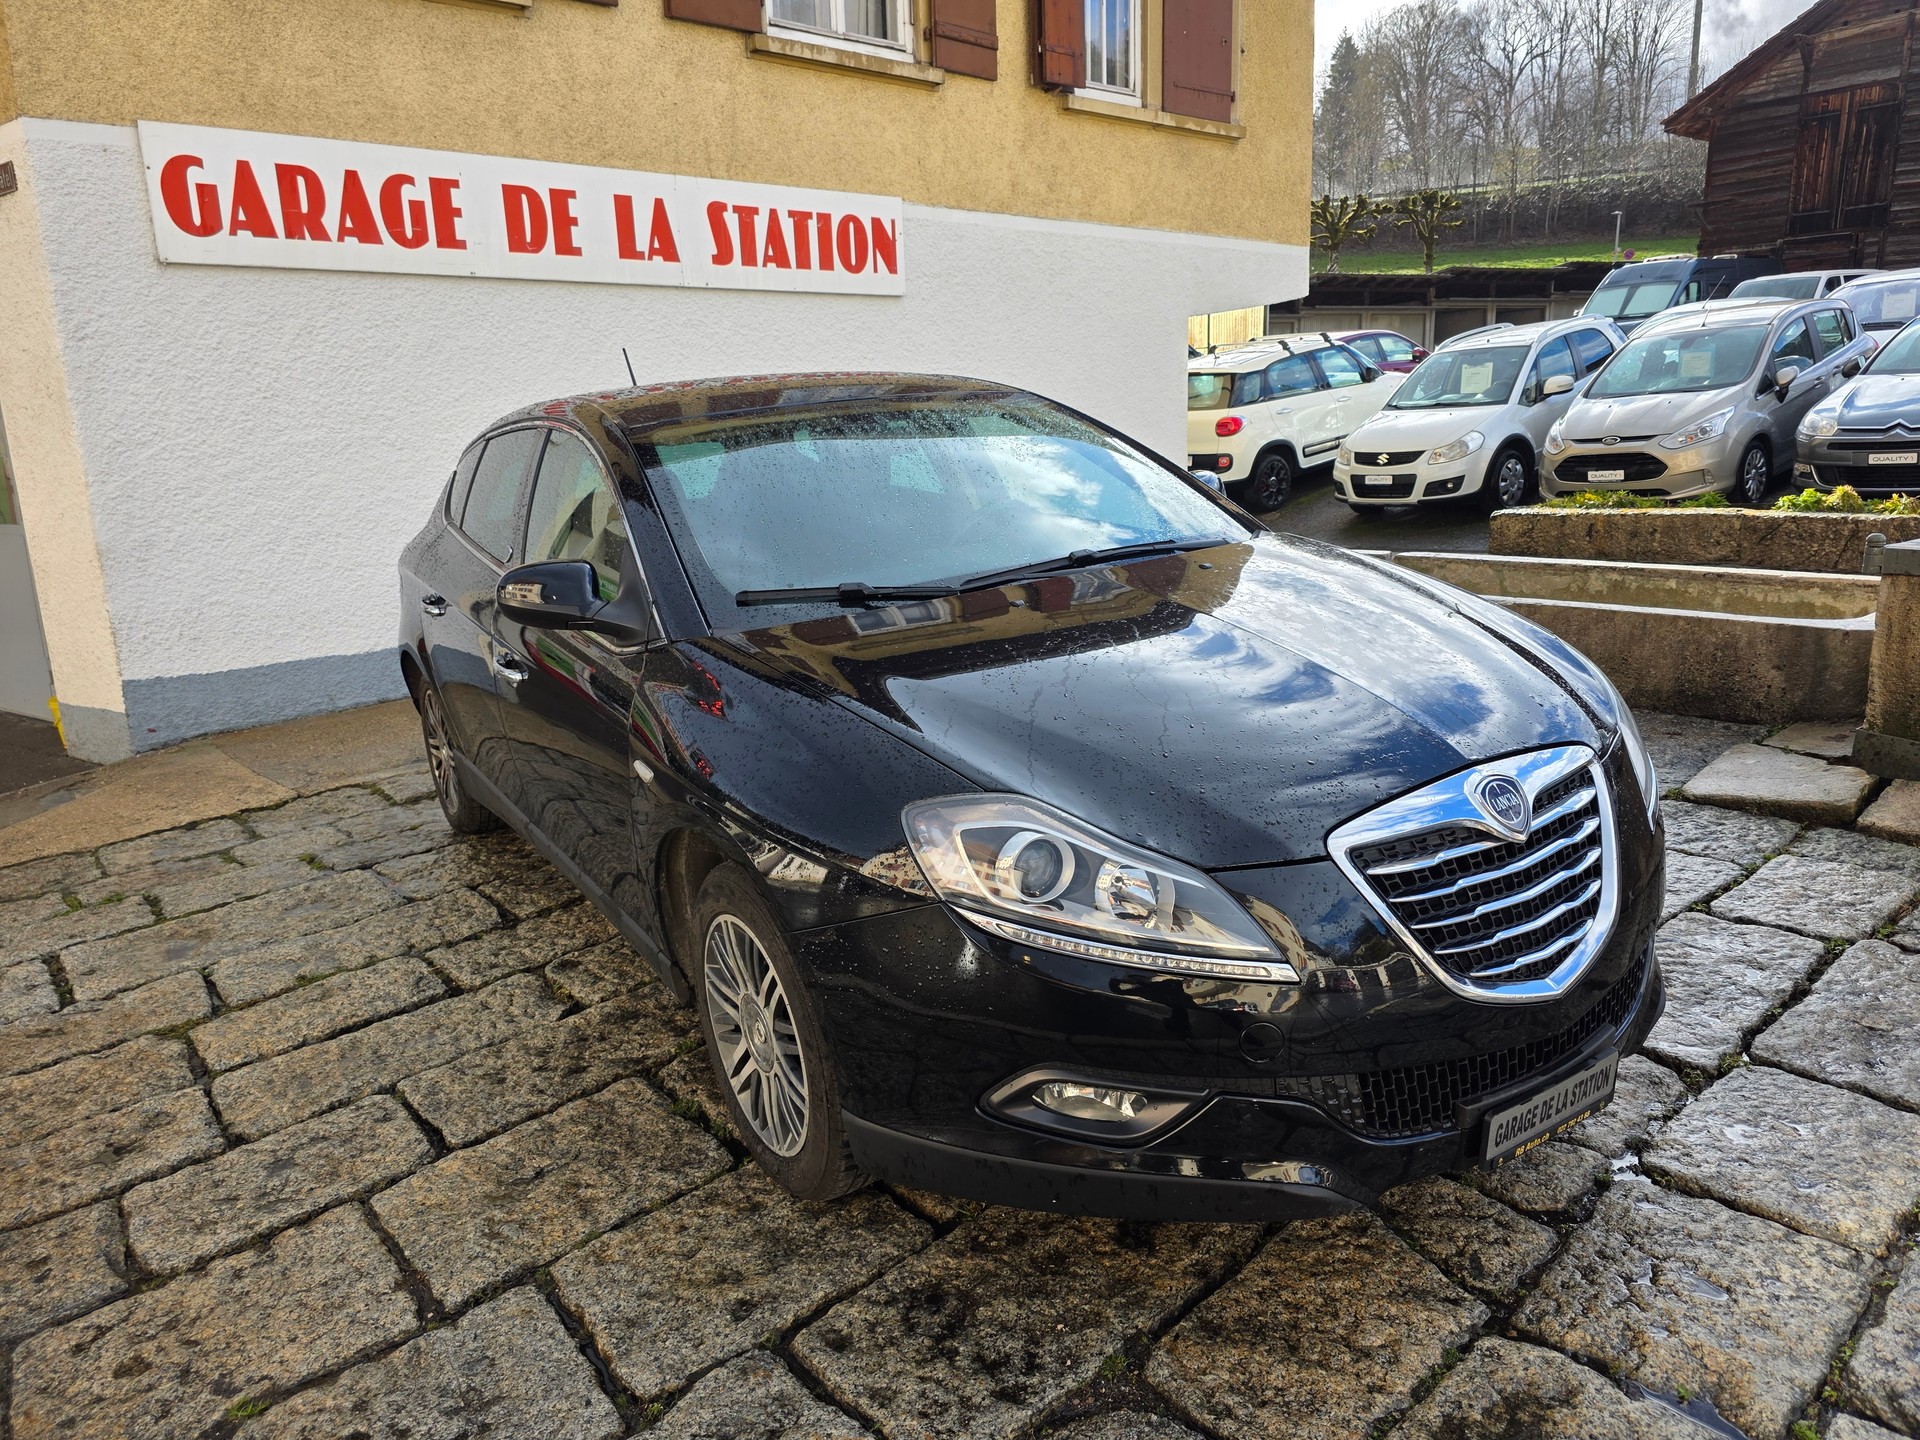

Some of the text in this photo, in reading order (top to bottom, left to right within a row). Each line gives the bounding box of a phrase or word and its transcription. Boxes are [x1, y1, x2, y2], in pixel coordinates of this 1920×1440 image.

[160, 154, 898, 275] GARAGE DE LA STATION
[1872, 455, 1909, 463] QUALITY
[1491, 793, 1519, 811] LANCIA
[1494, 1064, 1612, 1148] GARAGE DE LA STATION
